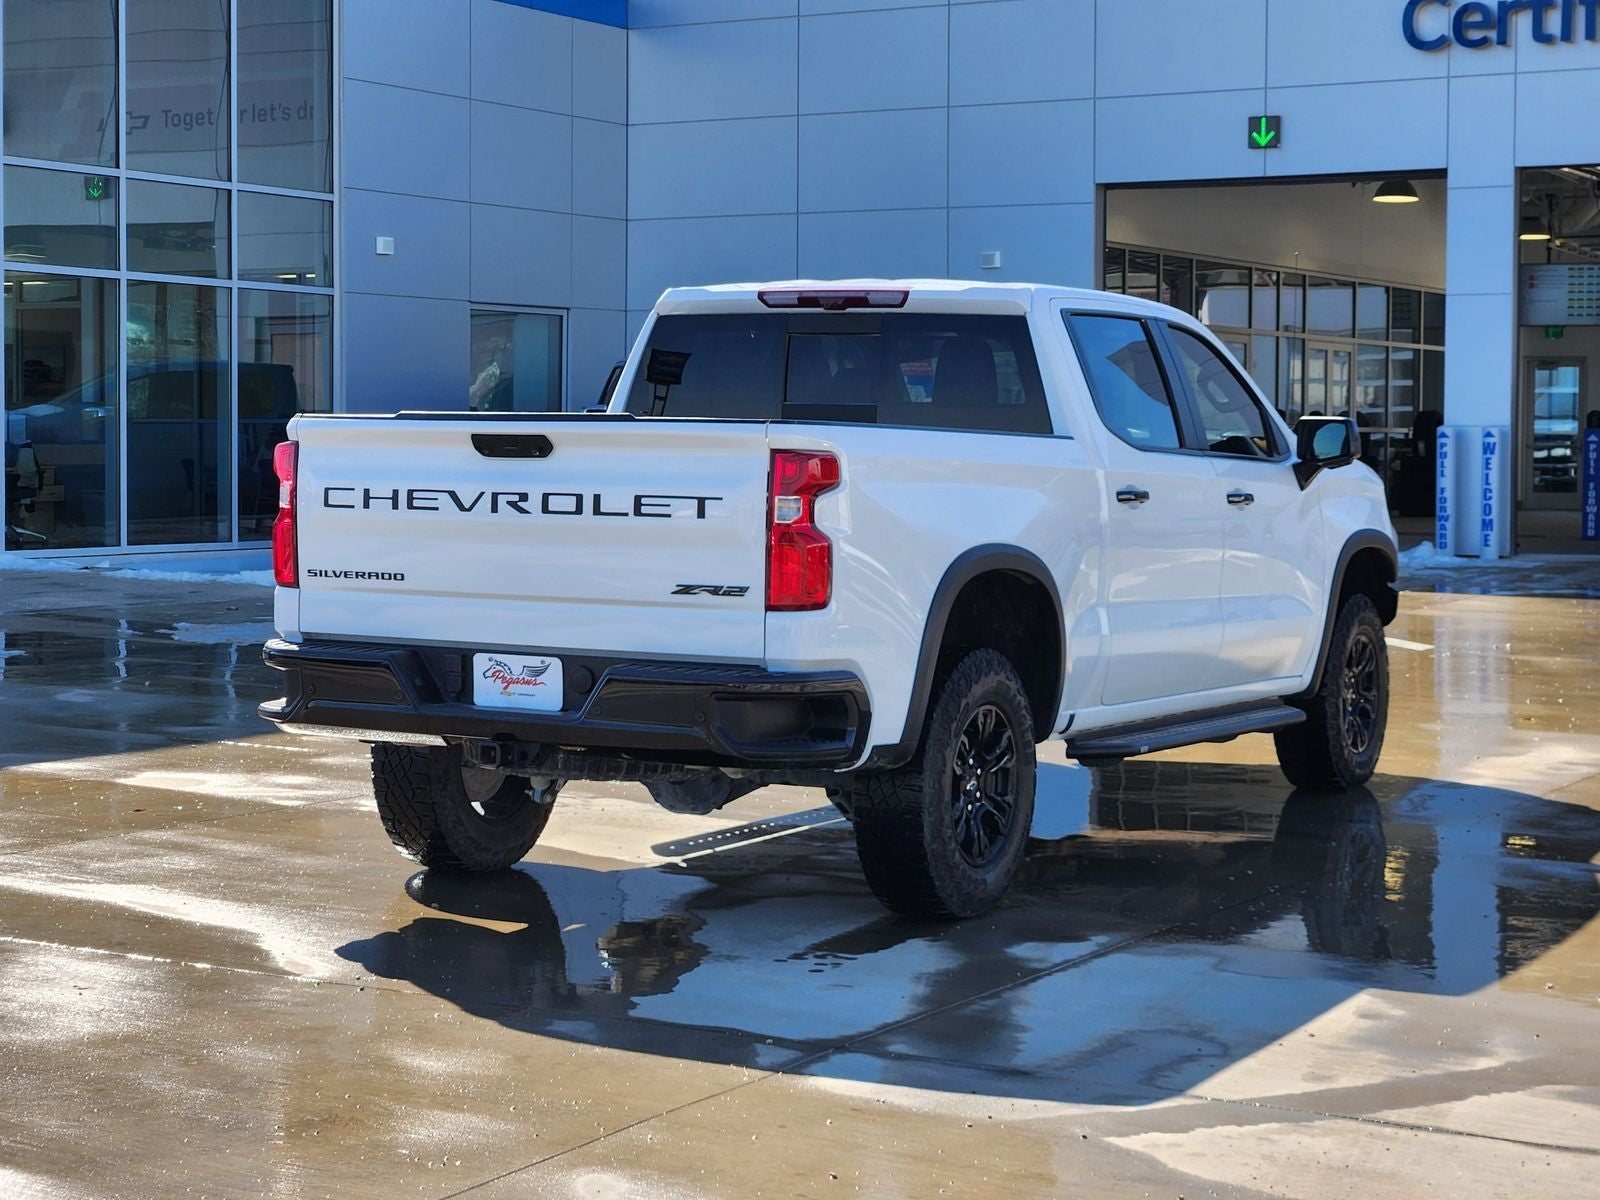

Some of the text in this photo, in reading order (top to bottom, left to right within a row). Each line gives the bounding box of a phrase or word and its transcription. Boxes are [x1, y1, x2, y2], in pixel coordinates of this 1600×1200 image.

[161, 107, 247, 132] Togetr
[251, 102, 291, 123] let's
[323, 486, 723, 519] CHEVROLET
[1437, 443, 1450, 550] PULL FORWARD
[1481, 442, 1496, 548] WELCOME
[1585, 444, 1598, 537] PULL FORWARD
[307, 569, 405, 581] SILVERADO
[670, 584, 750, 597] ZR2
[492, 669, 547, 691] Pegasus
